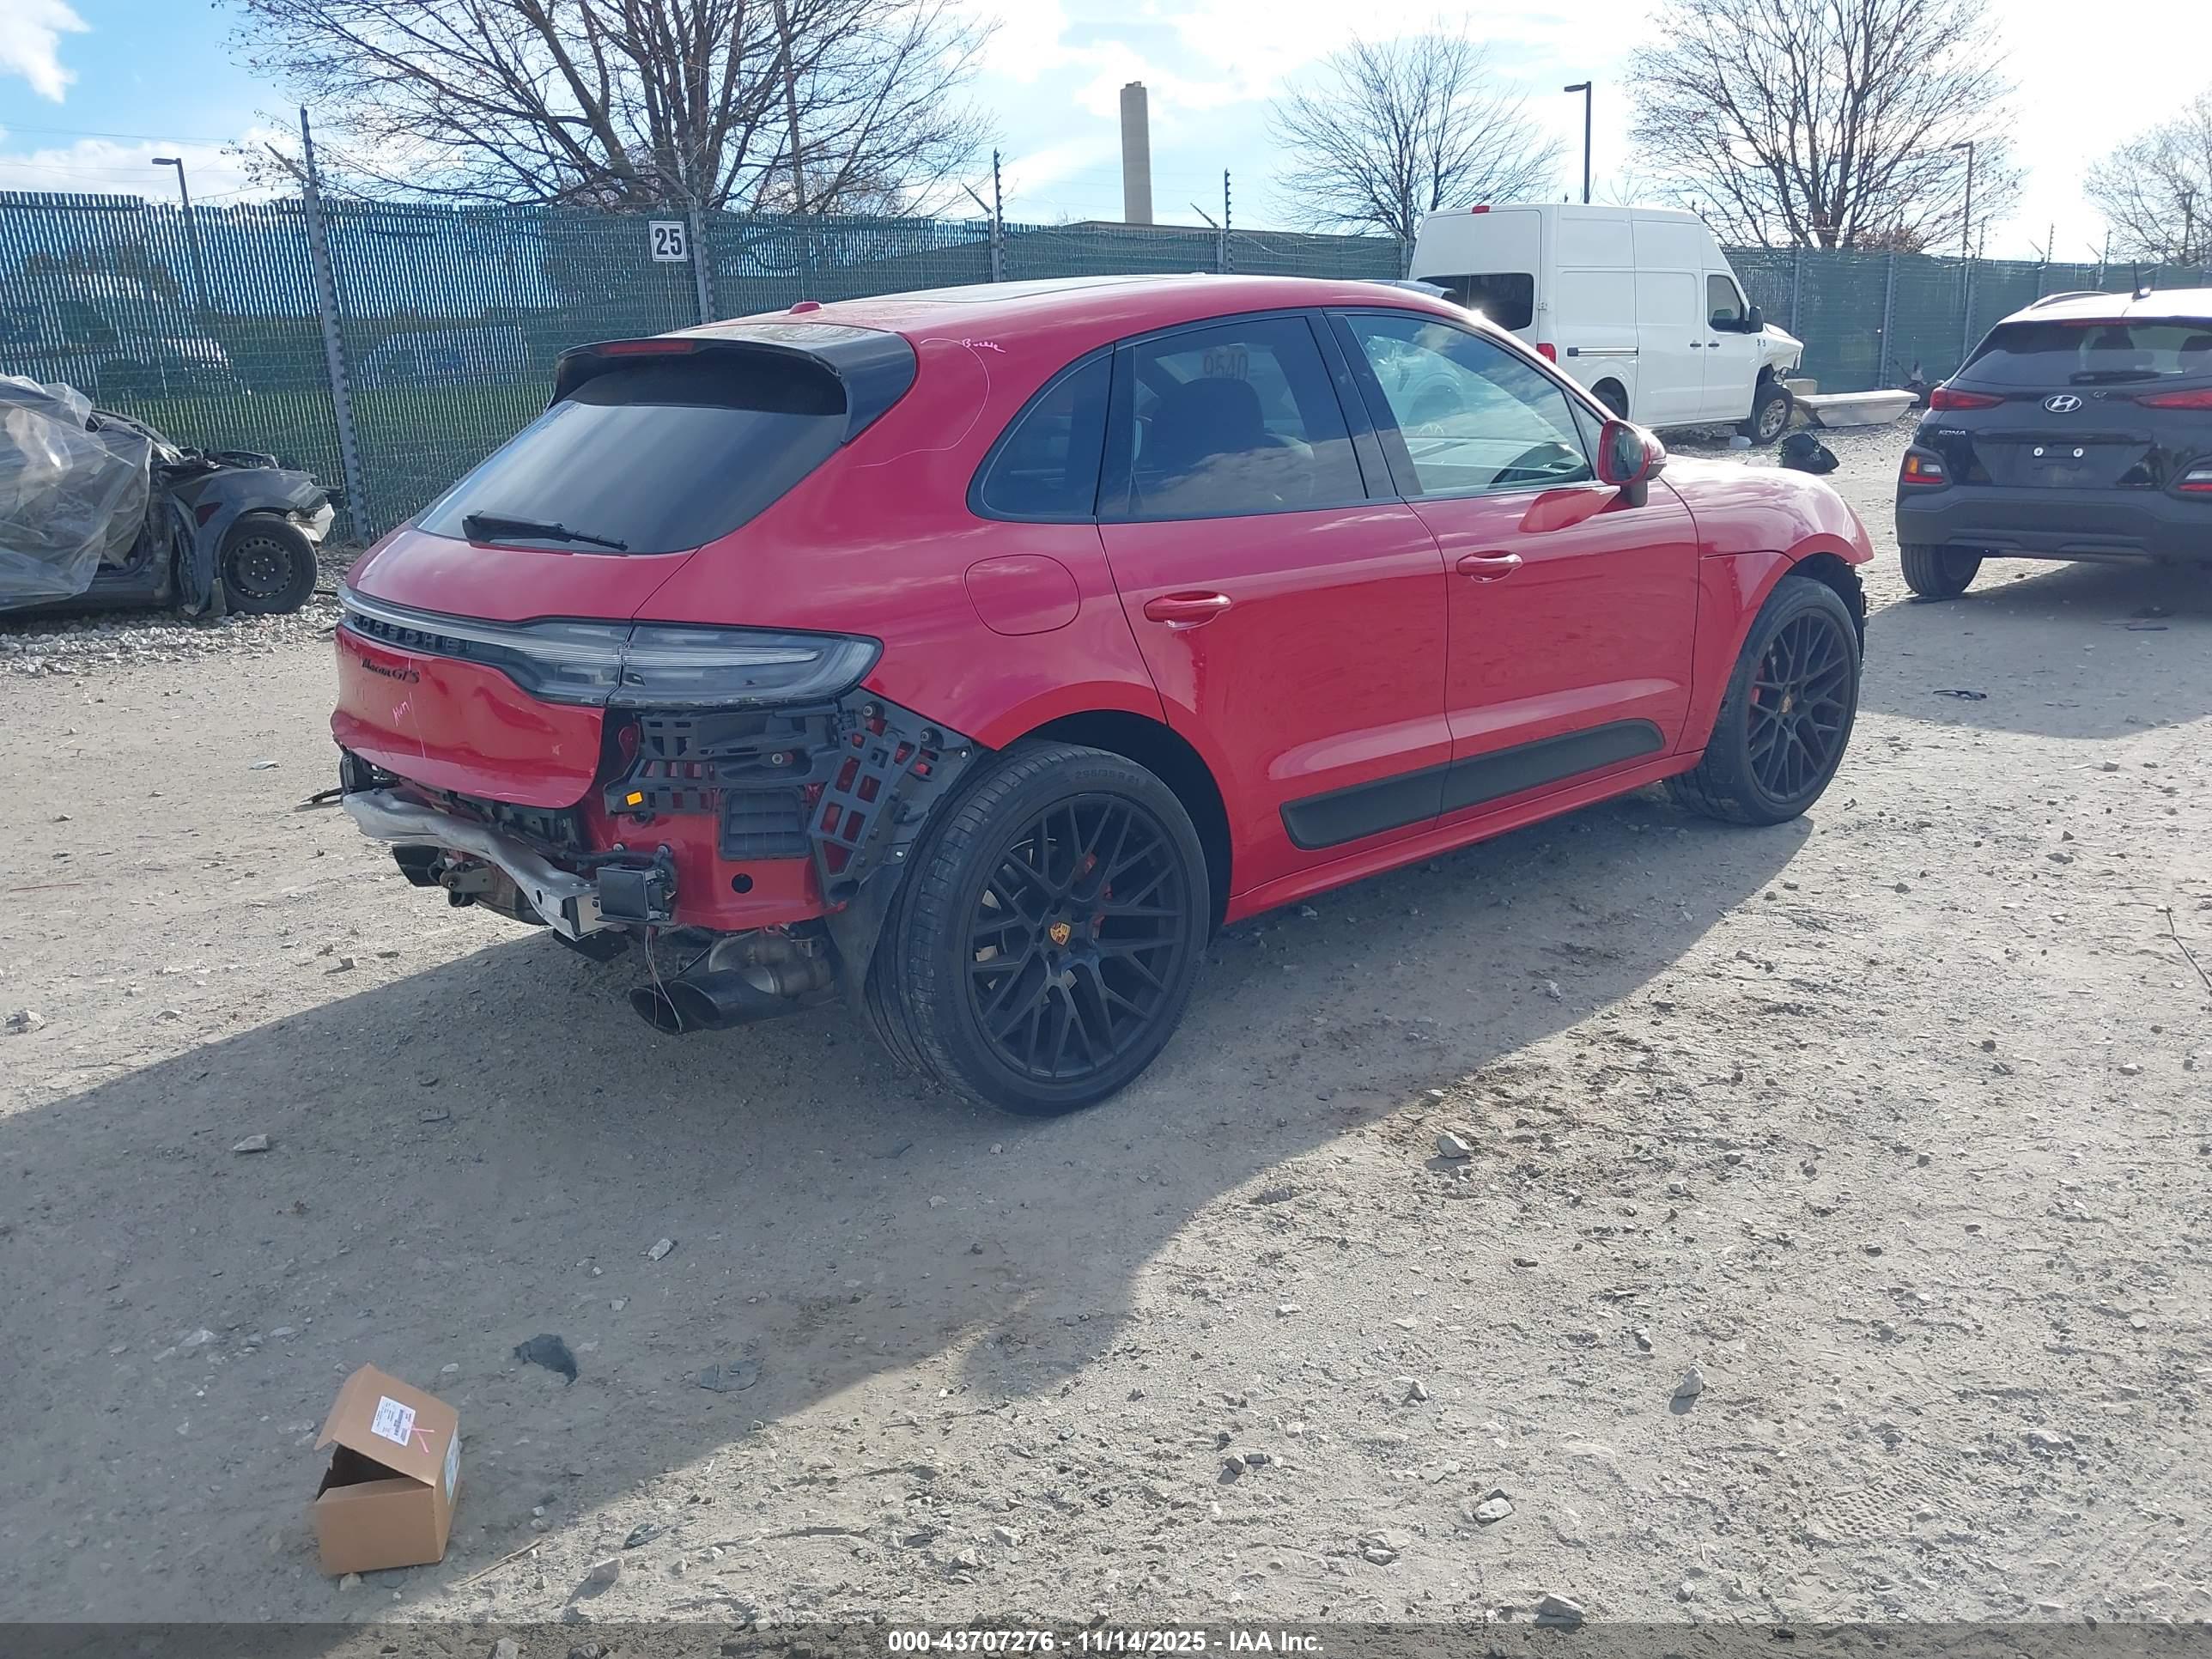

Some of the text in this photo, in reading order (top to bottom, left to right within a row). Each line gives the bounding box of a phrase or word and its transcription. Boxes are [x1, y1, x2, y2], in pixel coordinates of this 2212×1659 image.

[654, 228, 683, 255] 25
[351, 612, 460, 649] PORSCHE
[362, 658, 420, 684] Macan GTS
